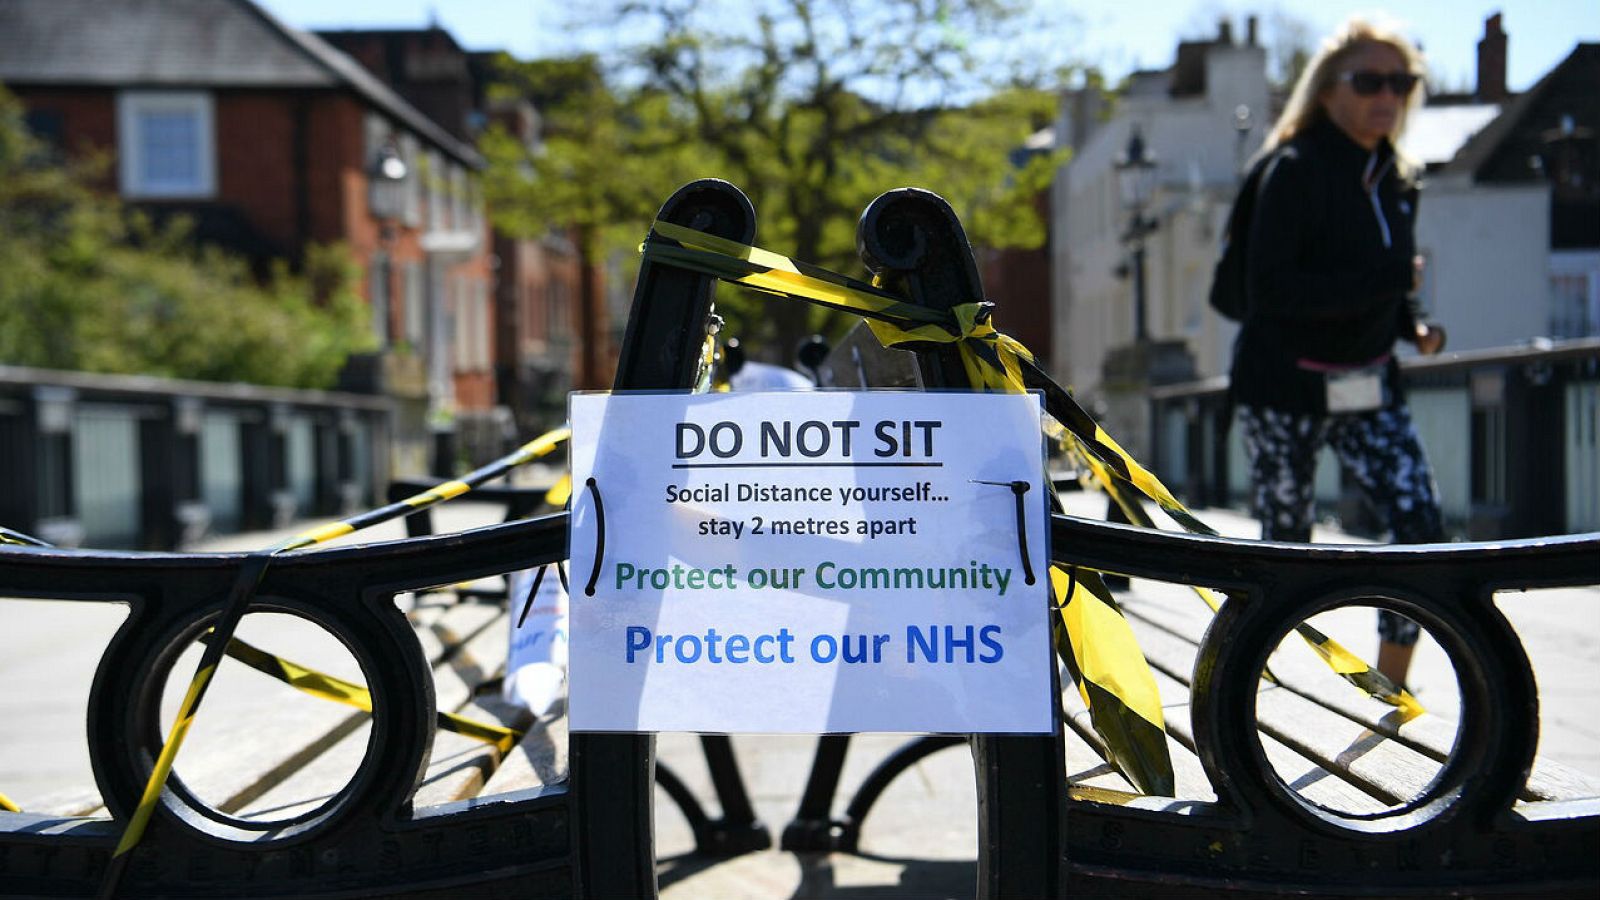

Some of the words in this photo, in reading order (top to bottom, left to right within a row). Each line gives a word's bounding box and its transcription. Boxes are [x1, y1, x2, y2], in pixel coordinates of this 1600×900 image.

[675, 421, 743, 457] DO
[760, 420, 860, 457] NOT
[873, 420, 942, 457] SIT
[665, 483, 729, 503] Social
[738, 483, 832, 502] Distance
[699, 515, 744, 538] stay
[751, 516, 764, 535] 2
[771, 515, 850, 535] metres
[856, 516, 916, 538] apart
[616, 562, 736, 589] Protect
[748, 568, 805, 589] our
[814, 561, 1012, 595] Community
[626, 626, 795, 664] Protect
[810, 634, 890, 664] our
[907, 625, 1004, 664] NHS
